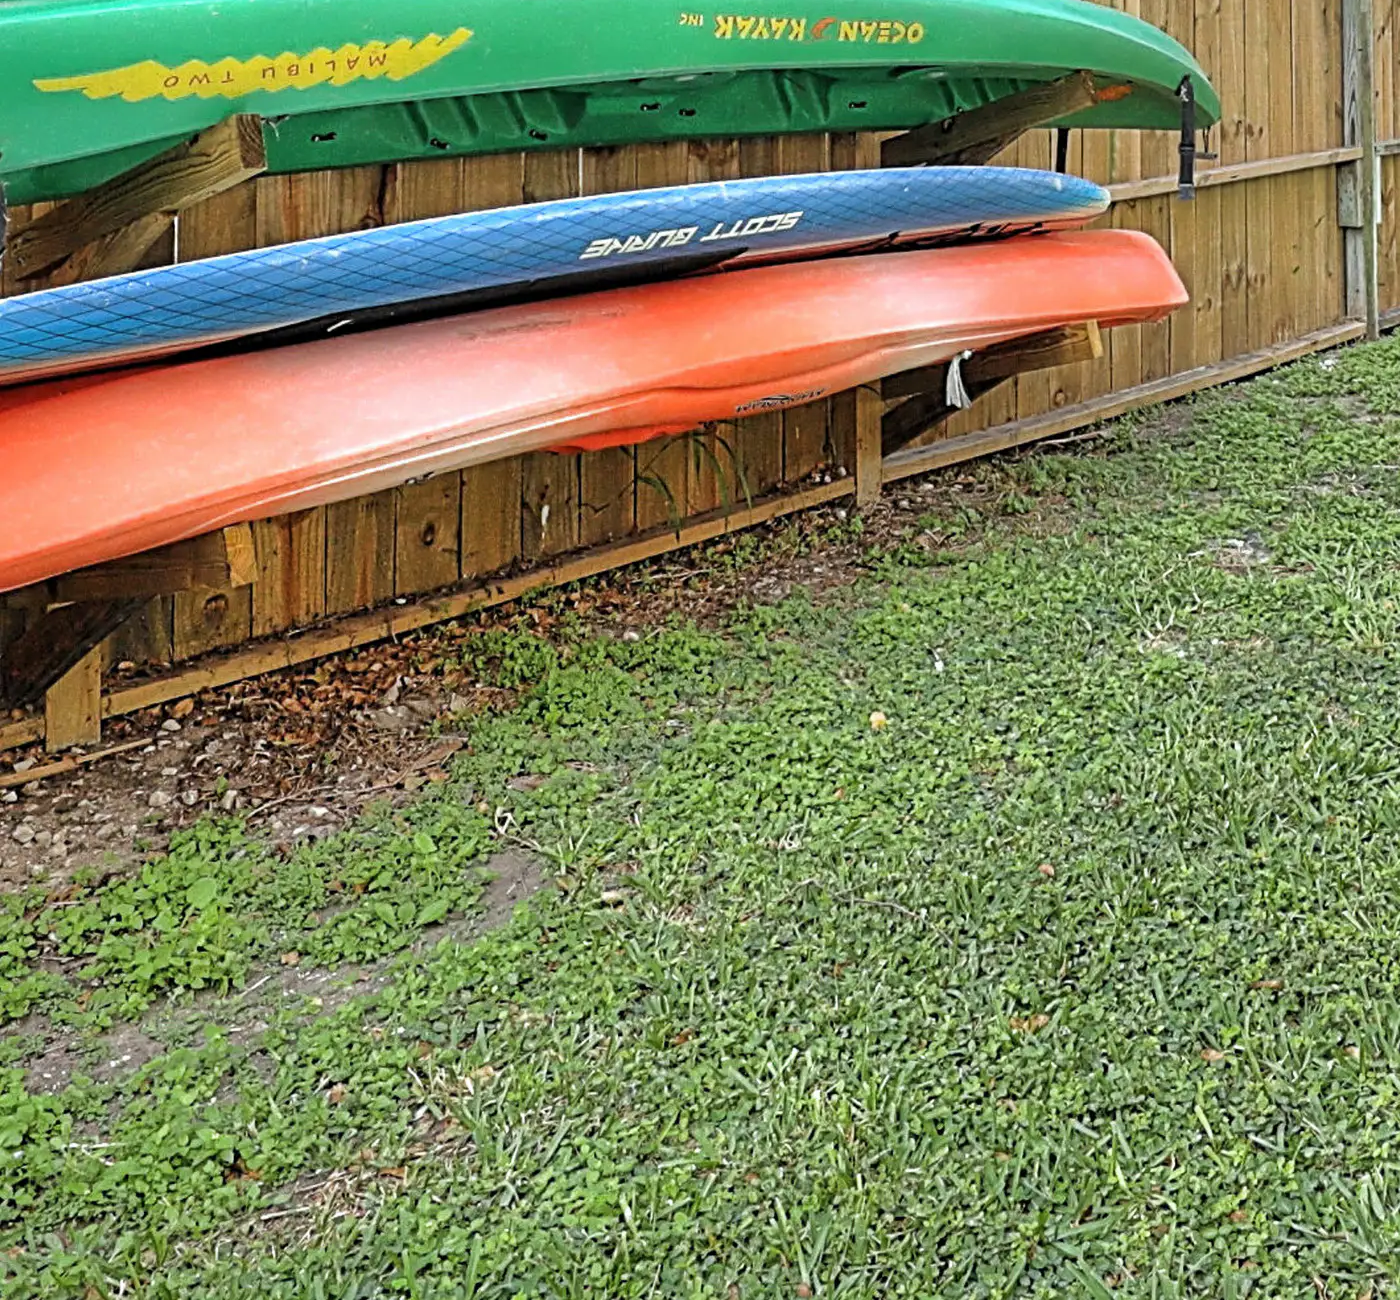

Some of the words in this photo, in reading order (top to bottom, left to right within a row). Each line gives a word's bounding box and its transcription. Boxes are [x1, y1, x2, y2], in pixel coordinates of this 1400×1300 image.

[679, 13, 704, 26] INC
[713, 15, 807, 41] KAYAK
[837, 20, 925, 44] OCEAN
[163, 69, 234, 89] TWO
[260, 52, 387, 80] MALIBU
[699, 211, 804, 242] SCOTT
[578, 226, 699, 260] BURKE
